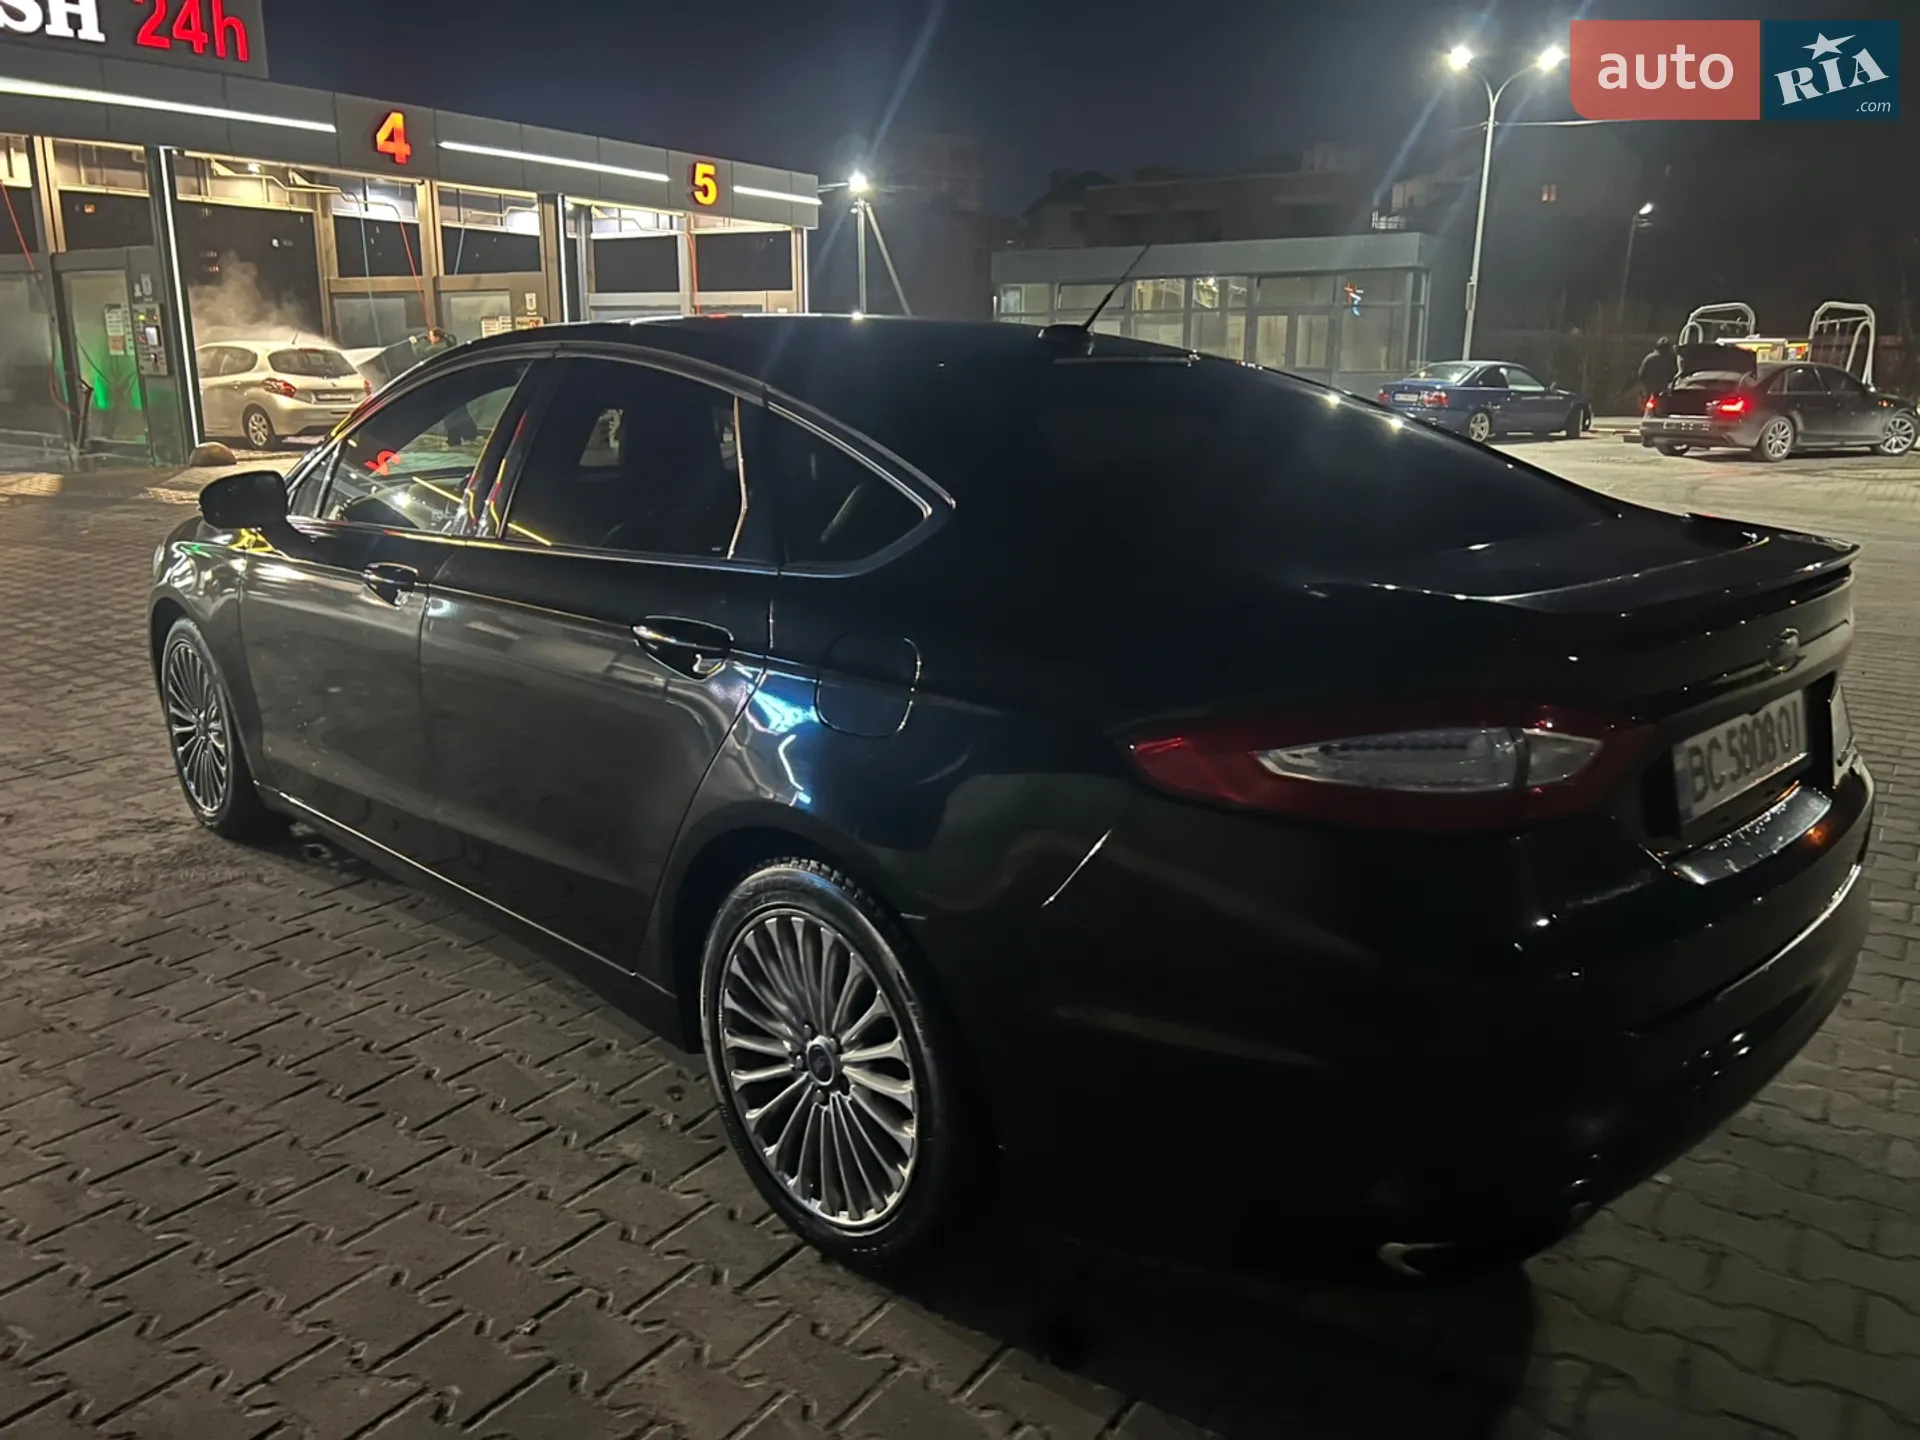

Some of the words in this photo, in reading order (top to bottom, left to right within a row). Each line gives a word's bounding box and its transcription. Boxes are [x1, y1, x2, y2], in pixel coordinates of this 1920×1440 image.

[134, 0, 248, 61] 24h
[375, 111, 411, 164] 4
[692, 162, 718, 206] 5
